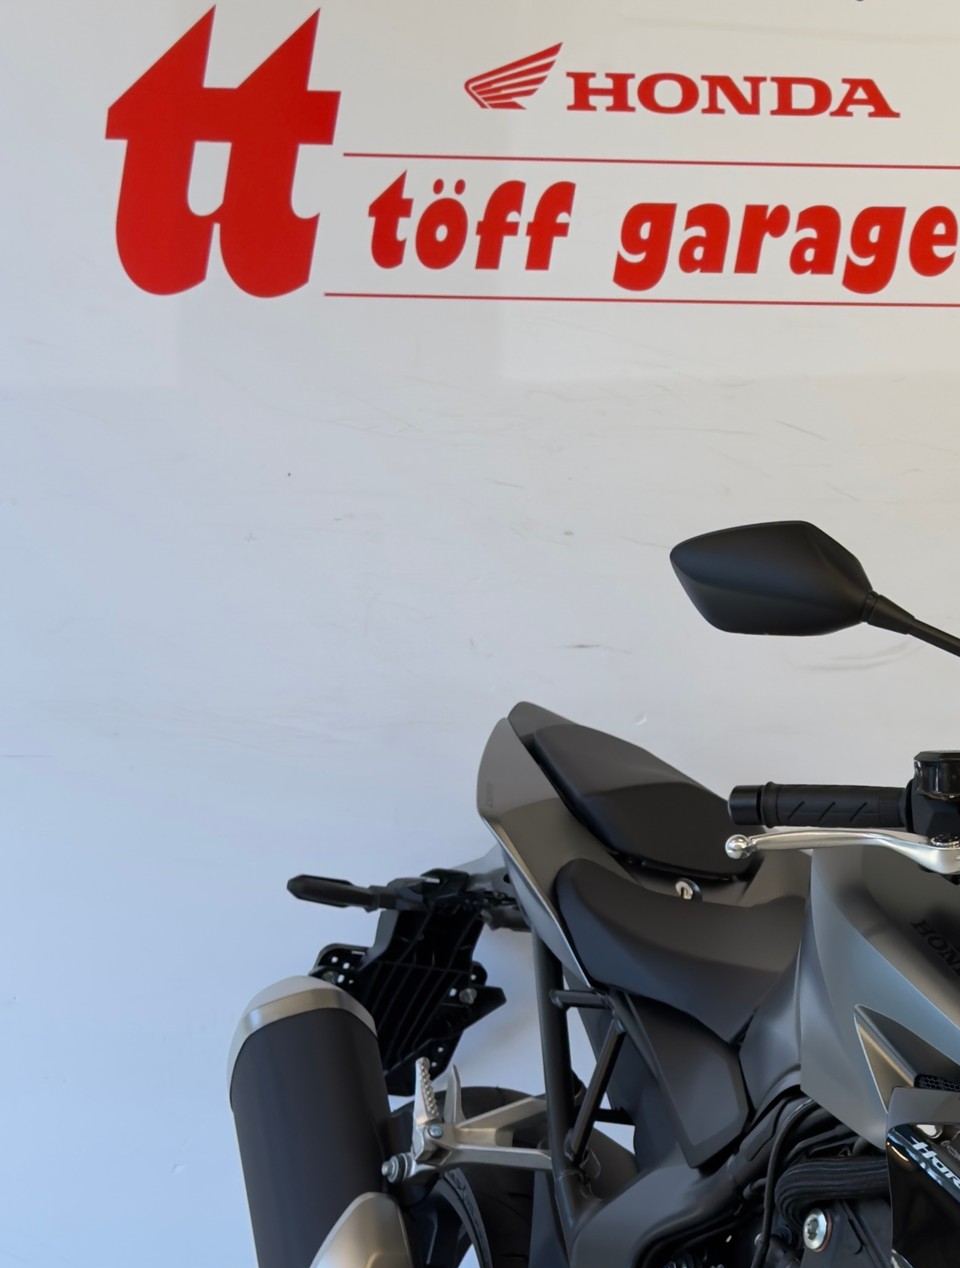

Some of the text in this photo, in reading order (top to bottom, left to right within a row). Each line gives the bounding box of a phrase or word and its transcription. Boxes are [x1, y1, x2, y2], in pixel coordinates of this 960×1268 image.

[565, 71, 901, 119] HONDA
[367, 171, 577, 272] töff
[612, 202, 959, 295] garage
